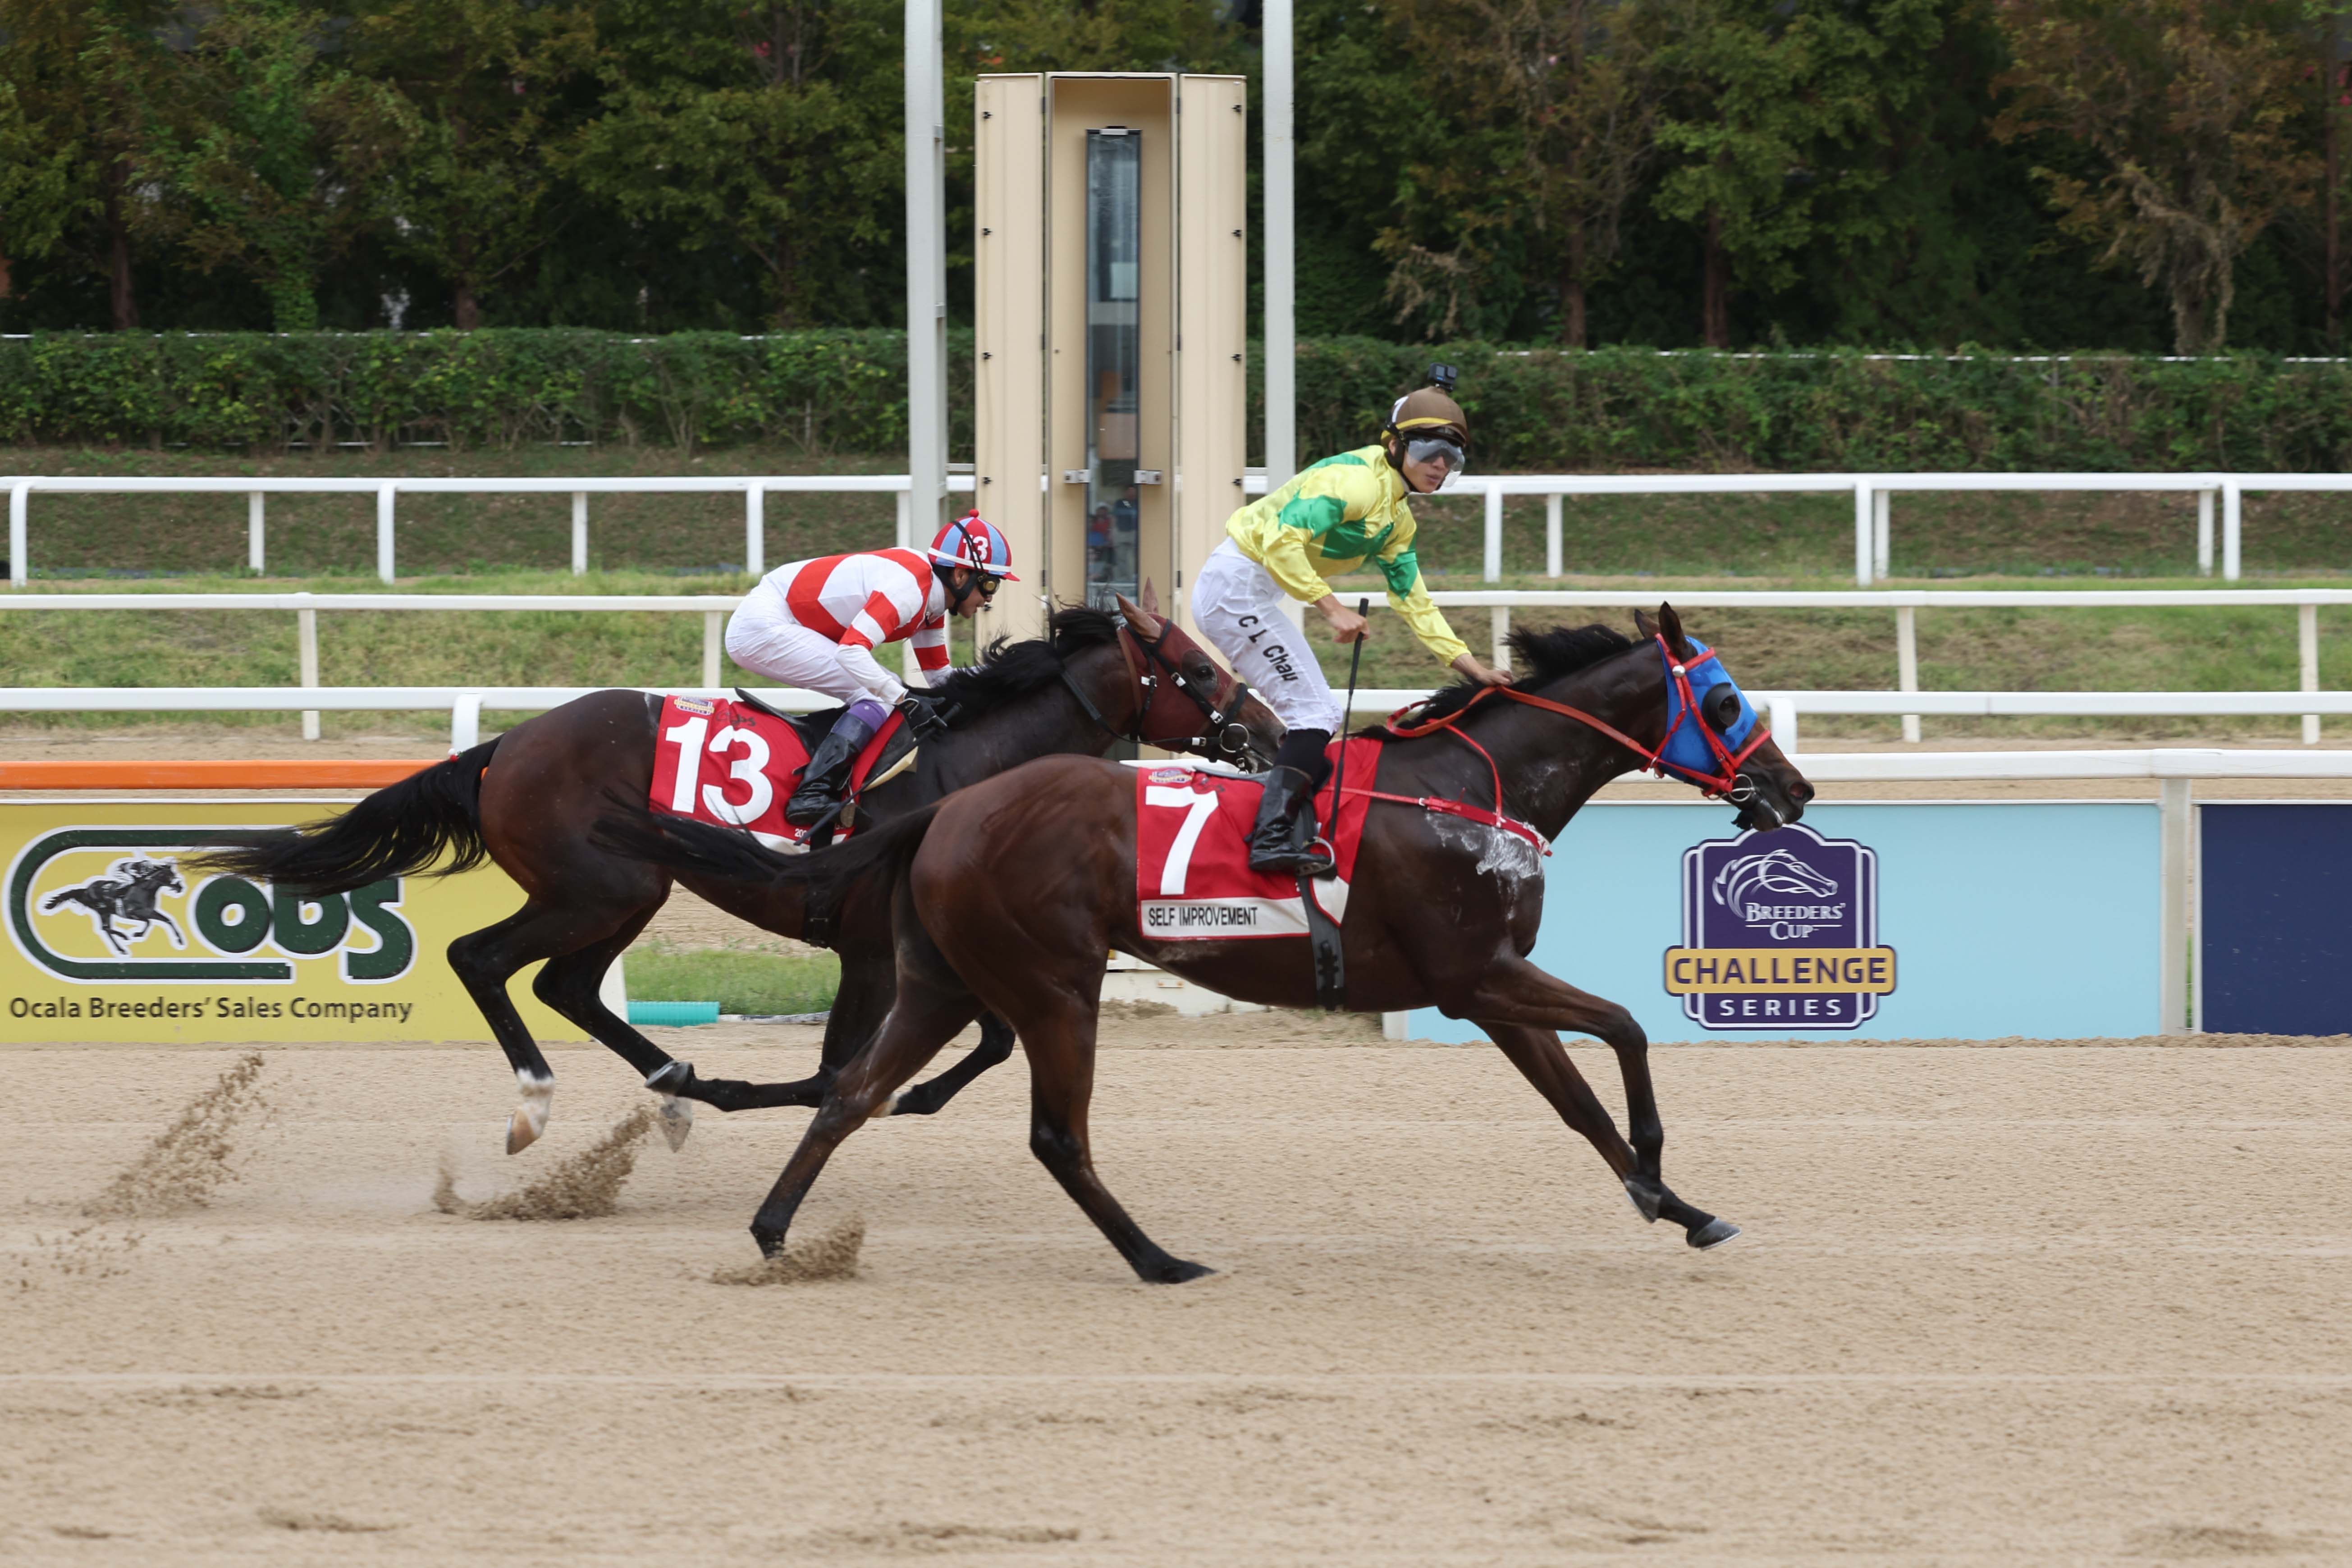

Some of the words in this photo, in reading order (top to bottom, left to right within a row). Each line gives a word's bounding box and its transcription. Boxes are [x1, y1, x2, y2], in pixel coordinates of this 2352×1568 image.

[963, 535, 988, 561] 13
[1238, 615, 1258, 627] C
[1248, 629, 1267, 643] L
[1263, 645, 1298, 681] Chau
[665, 717, 773, 824] 13
[1146, 786, 1218, 895] 7
[1149, 907, 1175, 926] SELF
[1179, 906, 1258, 926] IMPROVEMENT
[1673, 957, 1887, 984] CHALLENGE
[10, 996, 82, 1018] Ocala
[88, 996, 211, 1018] Breeders'
[217, 996, 283, 1018] Sales
[290, 997, 414, 1024] Company
[1719, 999, 1842, 1016] SERIES
